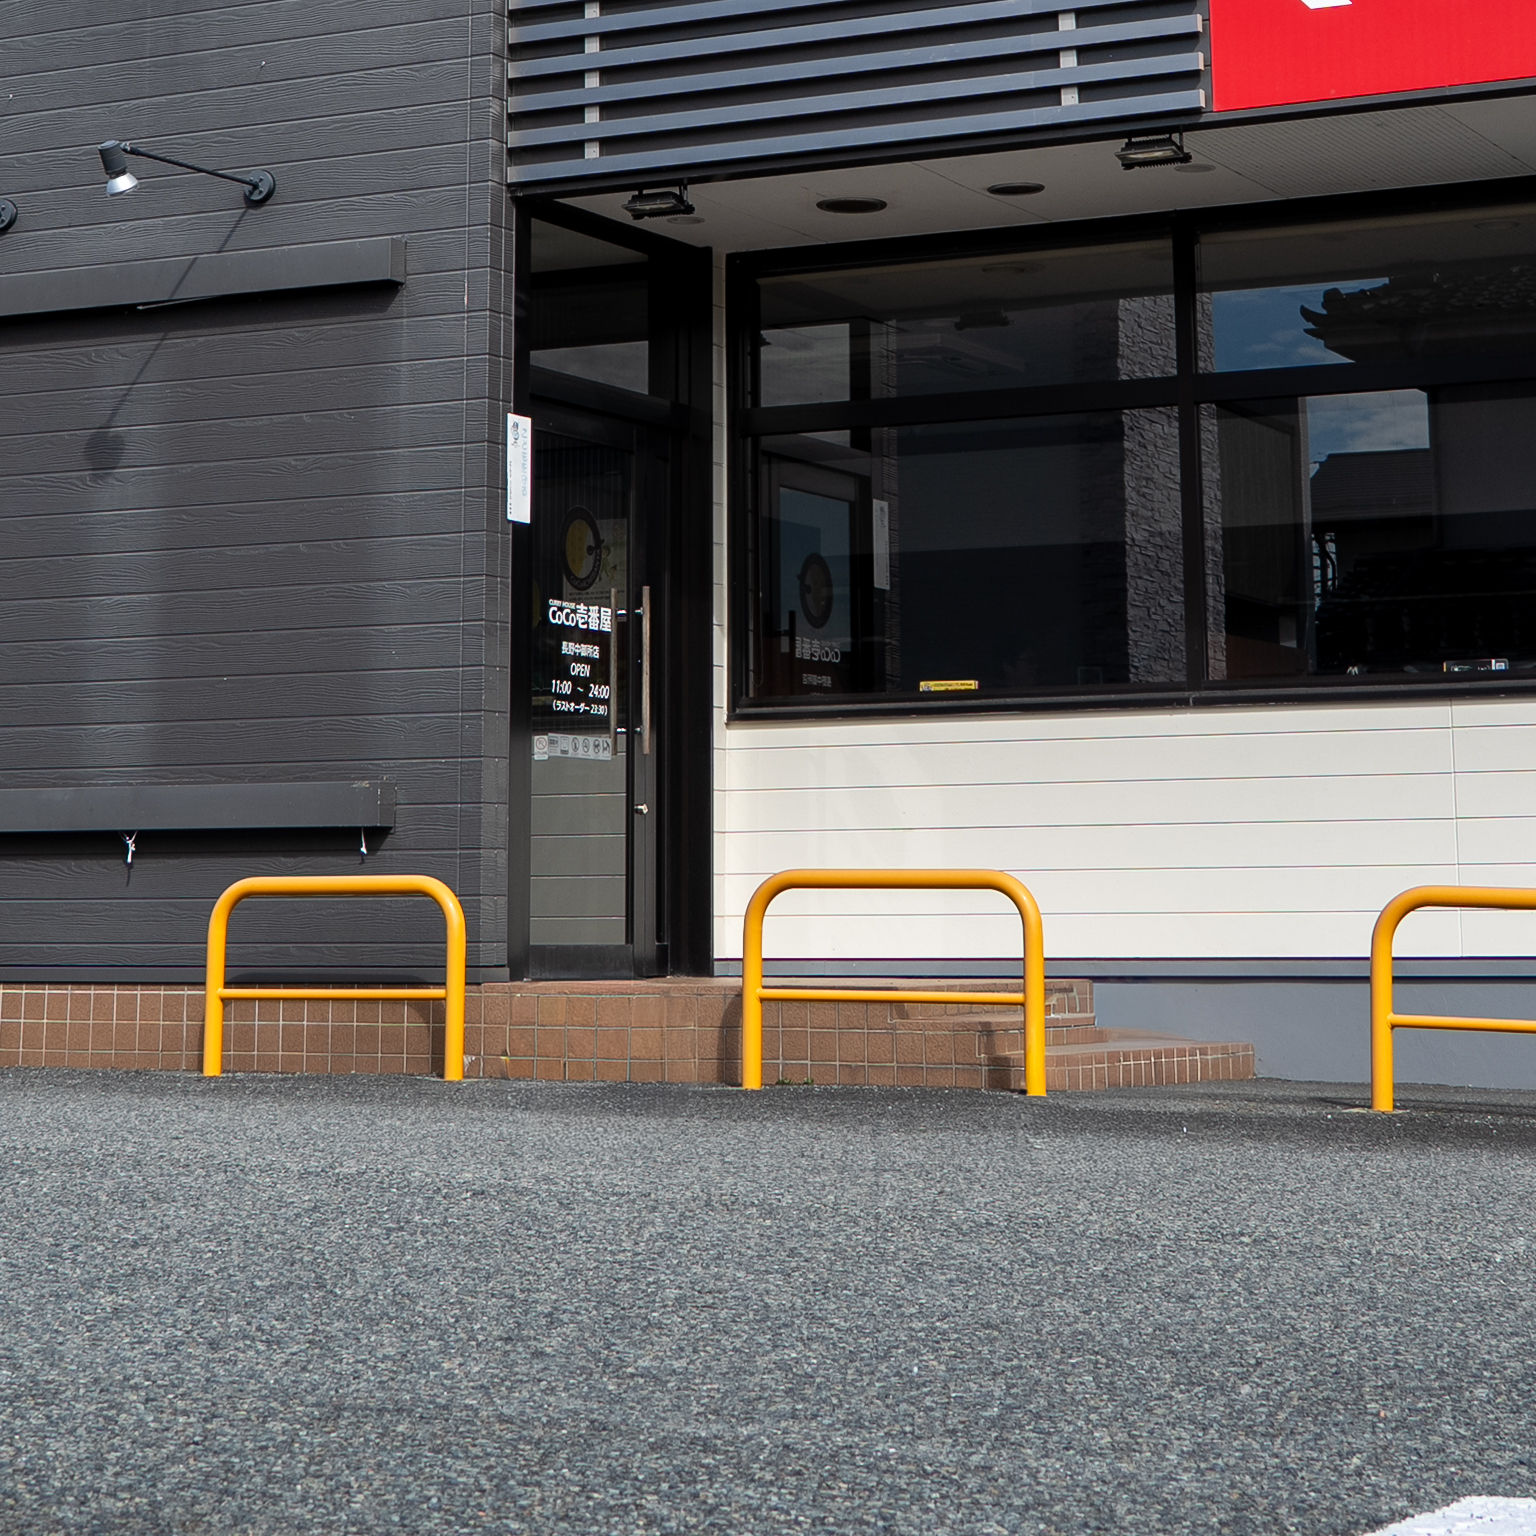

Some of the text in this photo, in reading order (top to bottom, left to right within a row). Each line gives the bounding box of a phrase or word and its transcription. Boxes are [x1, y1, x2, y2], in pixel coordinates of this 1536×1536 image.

[549, 603, 612, 632] CoCo壱番屋
[570, 662, 591, 677] OPEN
[551, 679, 572, 695] 11:00
[588, 683, 610, 699] 24:00
